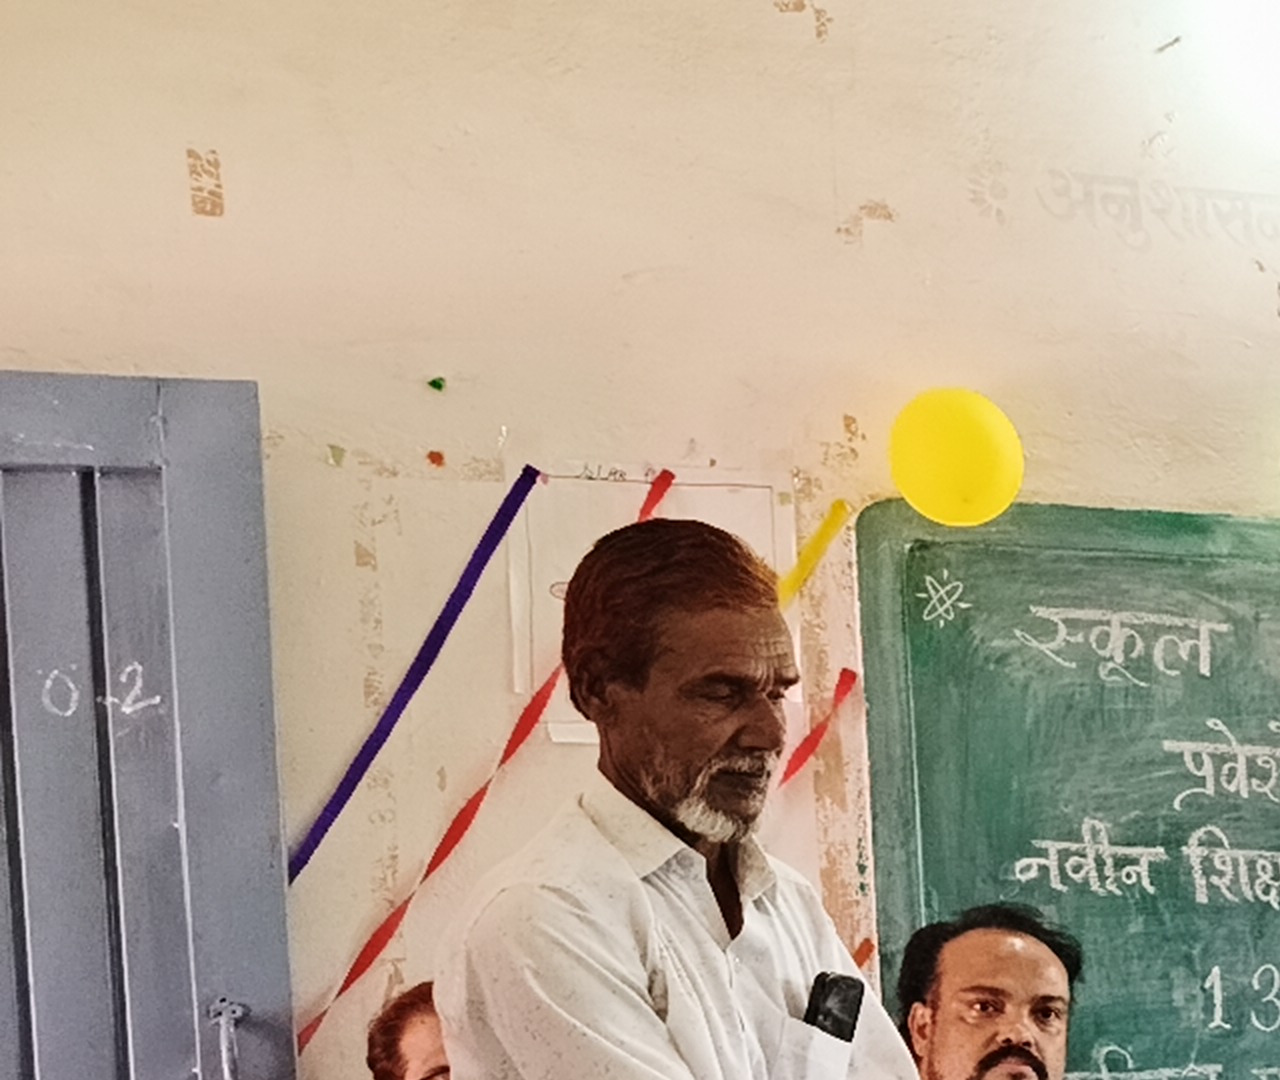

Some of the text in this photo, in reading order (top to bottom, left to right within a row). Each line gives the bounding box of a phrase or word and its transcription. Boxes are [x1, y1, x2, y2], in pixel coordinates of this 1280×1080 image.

[1013, 605, 1233, 688] स्कूल
[1014, 816, 1169, 897] नवीन
[1203, 963, 1233, 1030] 1
